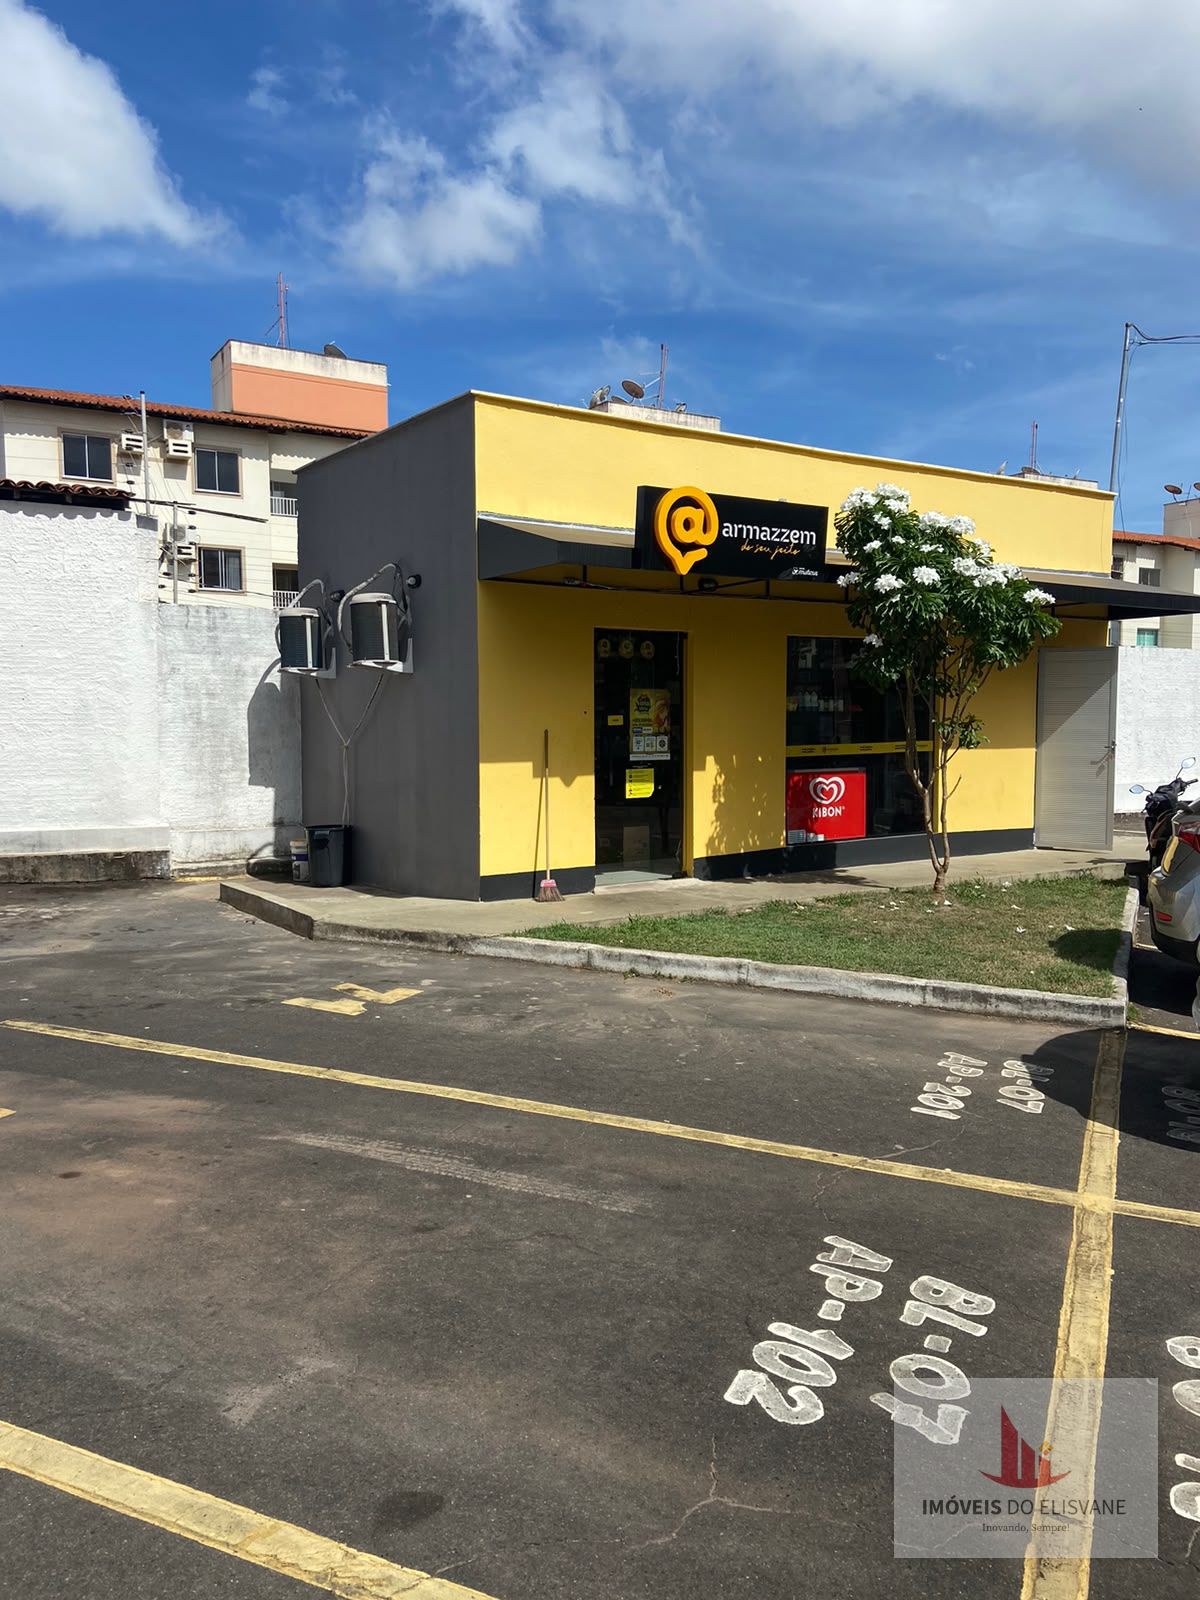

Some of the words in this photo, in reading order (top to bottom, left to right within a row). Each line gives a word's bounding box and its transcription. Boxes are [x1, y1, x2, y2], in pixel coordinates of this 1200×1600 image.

[721, 522, 817, 545] armazzem
[812, 806, 843, 819] KIBON
[724, 1235, 893, 1424] AP-102
[870, 1275, 996, 1445] BL-07
